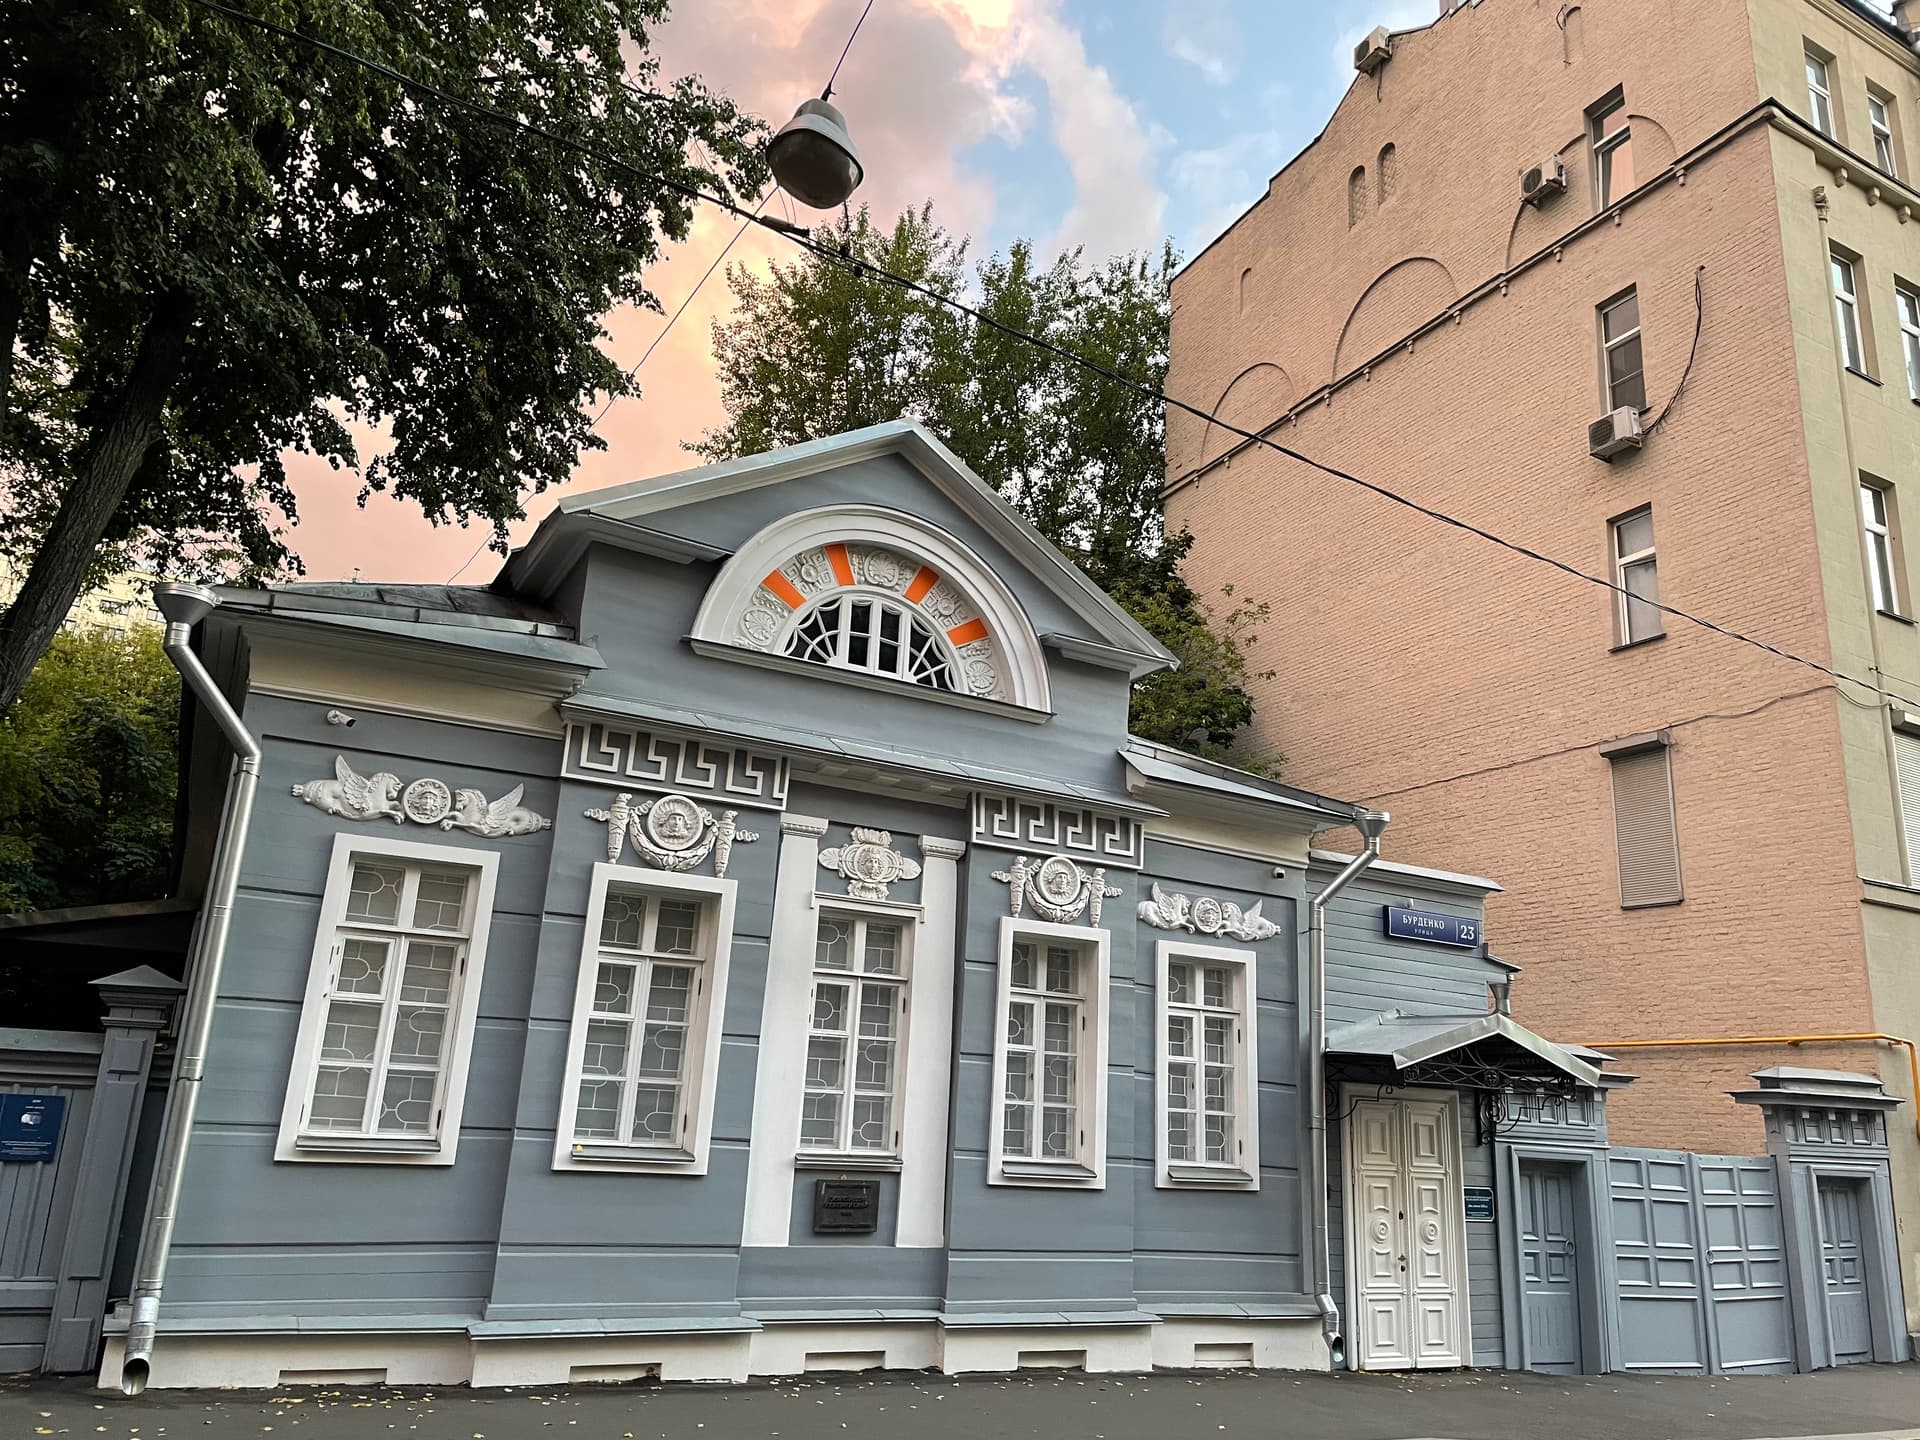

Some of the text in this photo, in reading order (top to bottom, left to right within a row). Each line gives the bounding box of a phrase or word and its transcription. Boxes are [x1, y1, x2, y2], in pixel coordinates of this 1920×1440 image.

[1402, 914, 1445, 930] БУРДЕНКО
[1414, 928, 1434, 936] УЛИЦА
[1460, 925, 1475, 940] 23
